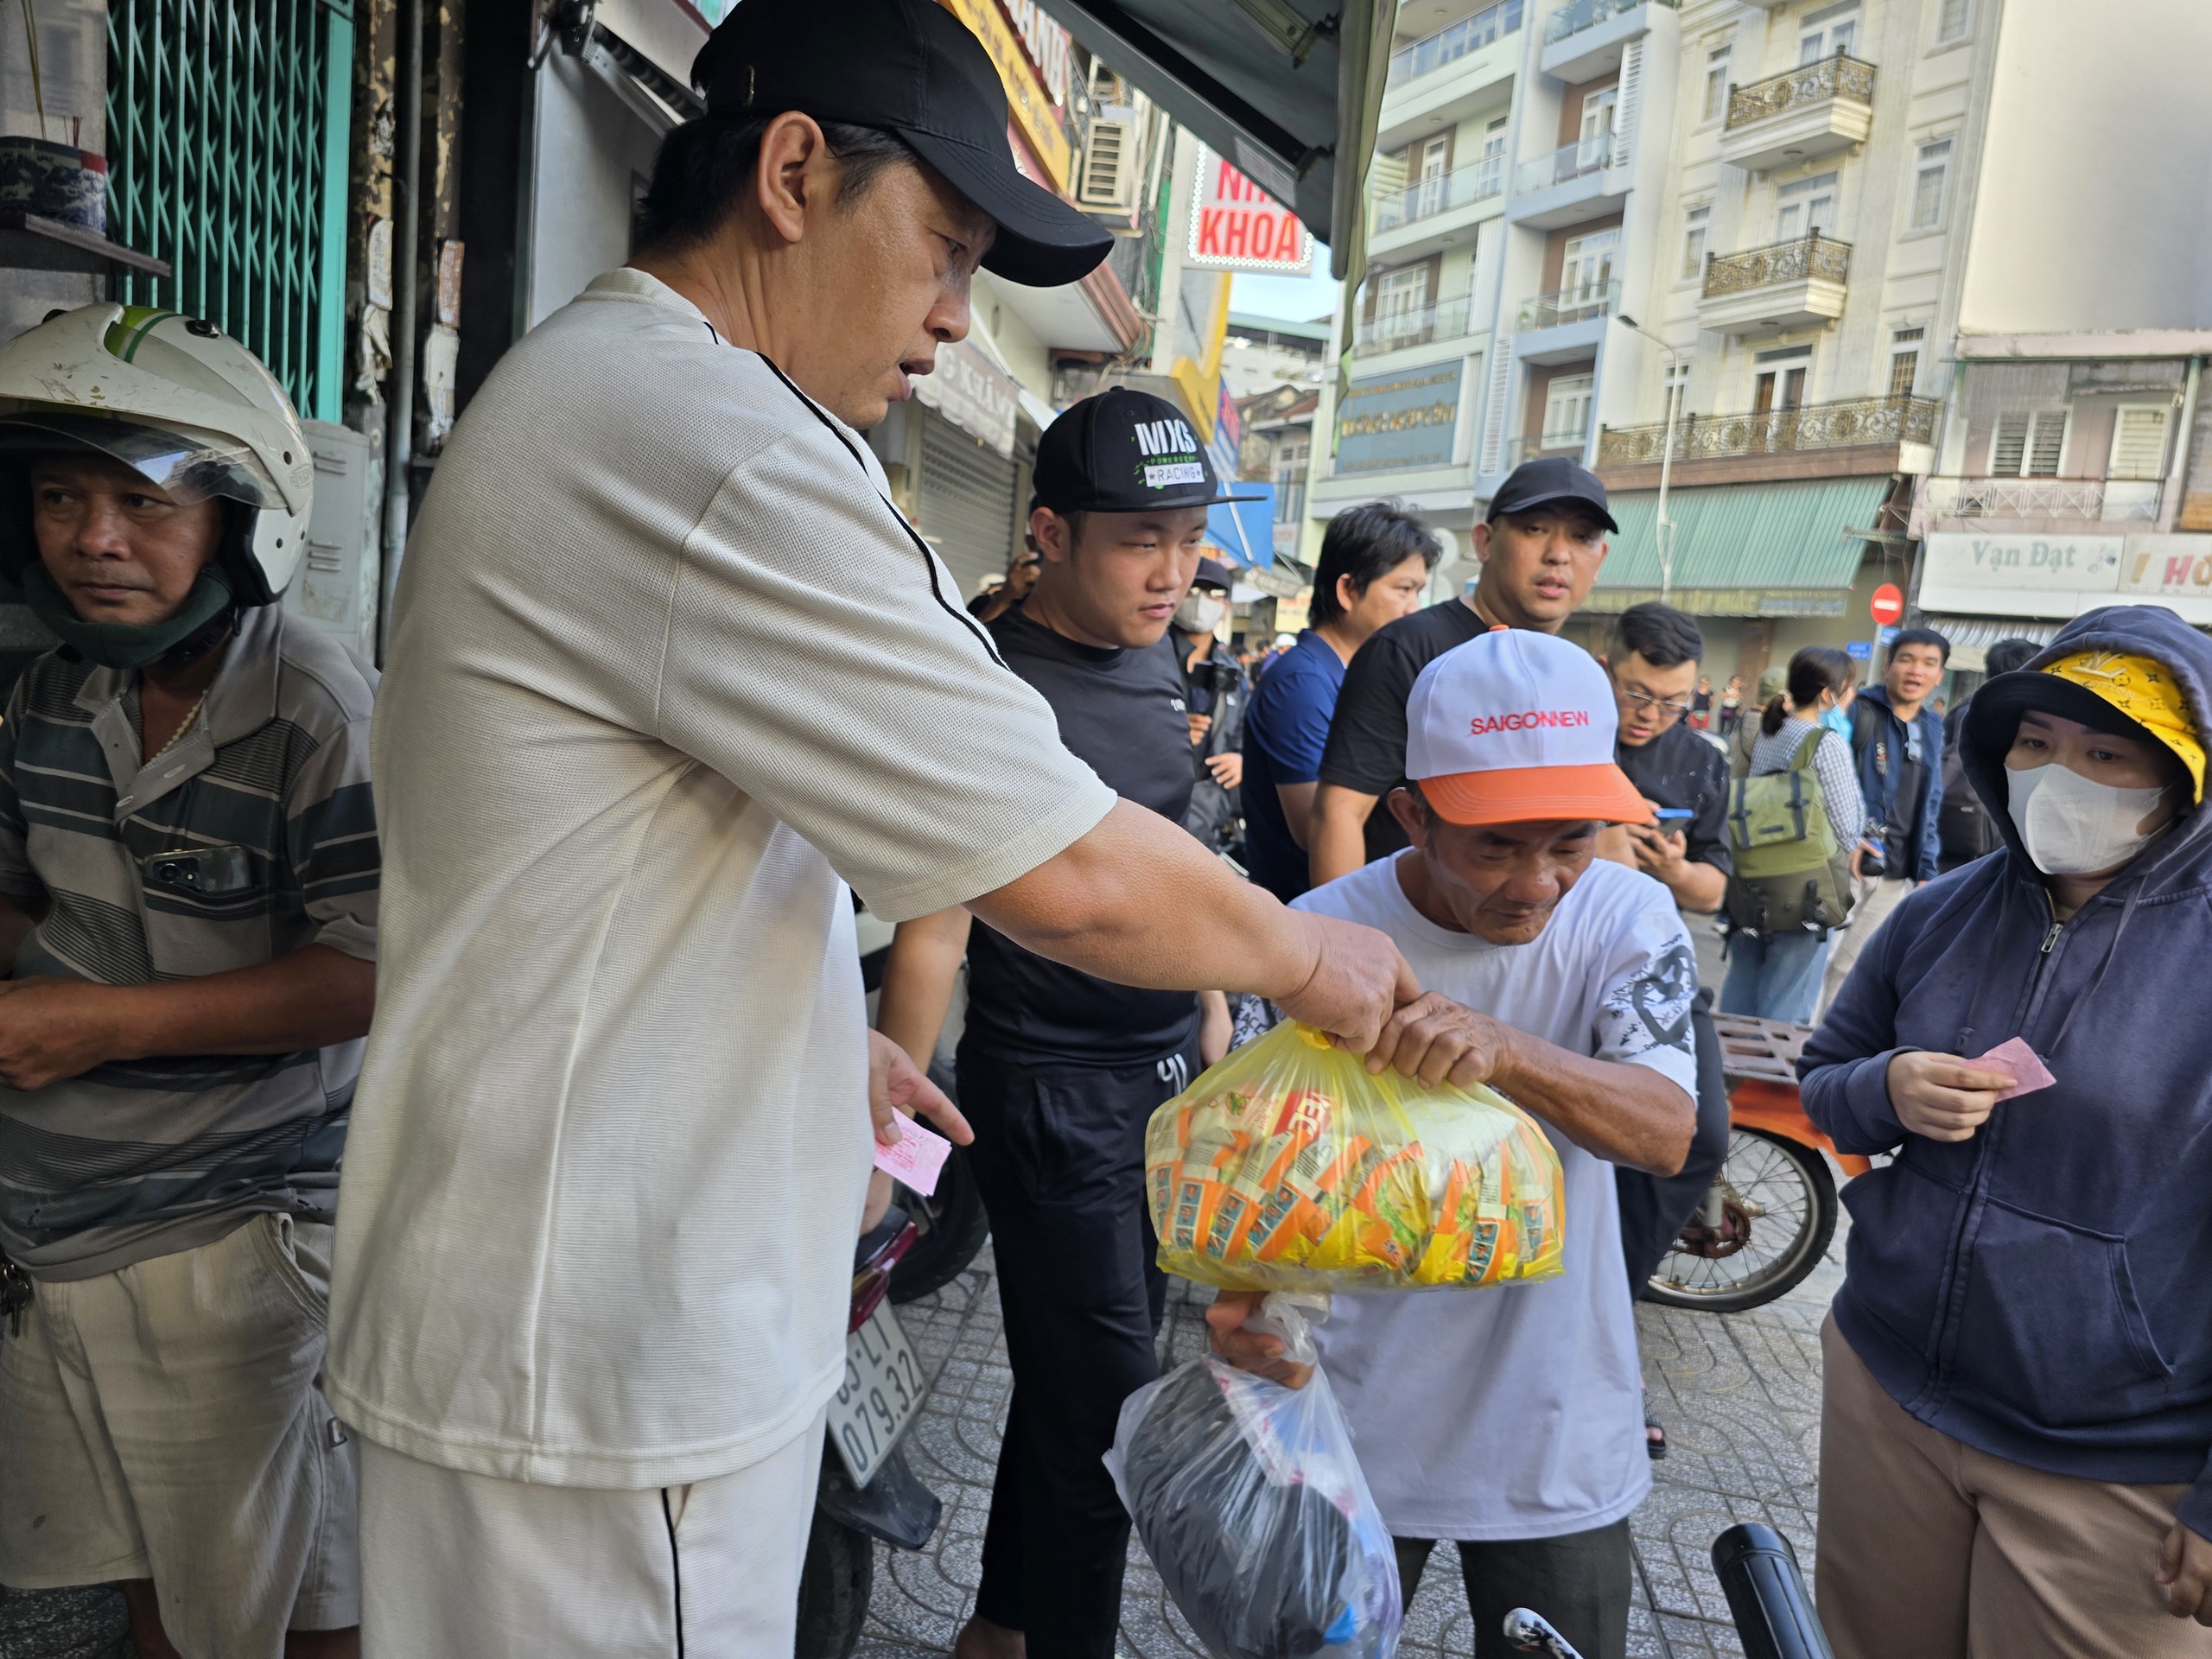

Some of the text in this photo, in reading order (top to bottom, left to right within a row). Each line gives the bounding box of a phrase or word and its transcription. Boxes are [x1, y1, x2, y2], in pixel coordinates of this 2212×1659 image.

[1198, 209, 1300, 263] KHOA
[1157, 467, 1196, 481] RACING
[1972, 540, 2075, 573] Vạn Đạt
[1471, 710, 1589, 734] SAIGONNEW
[842, 1348, 923, 1472] 079.32
